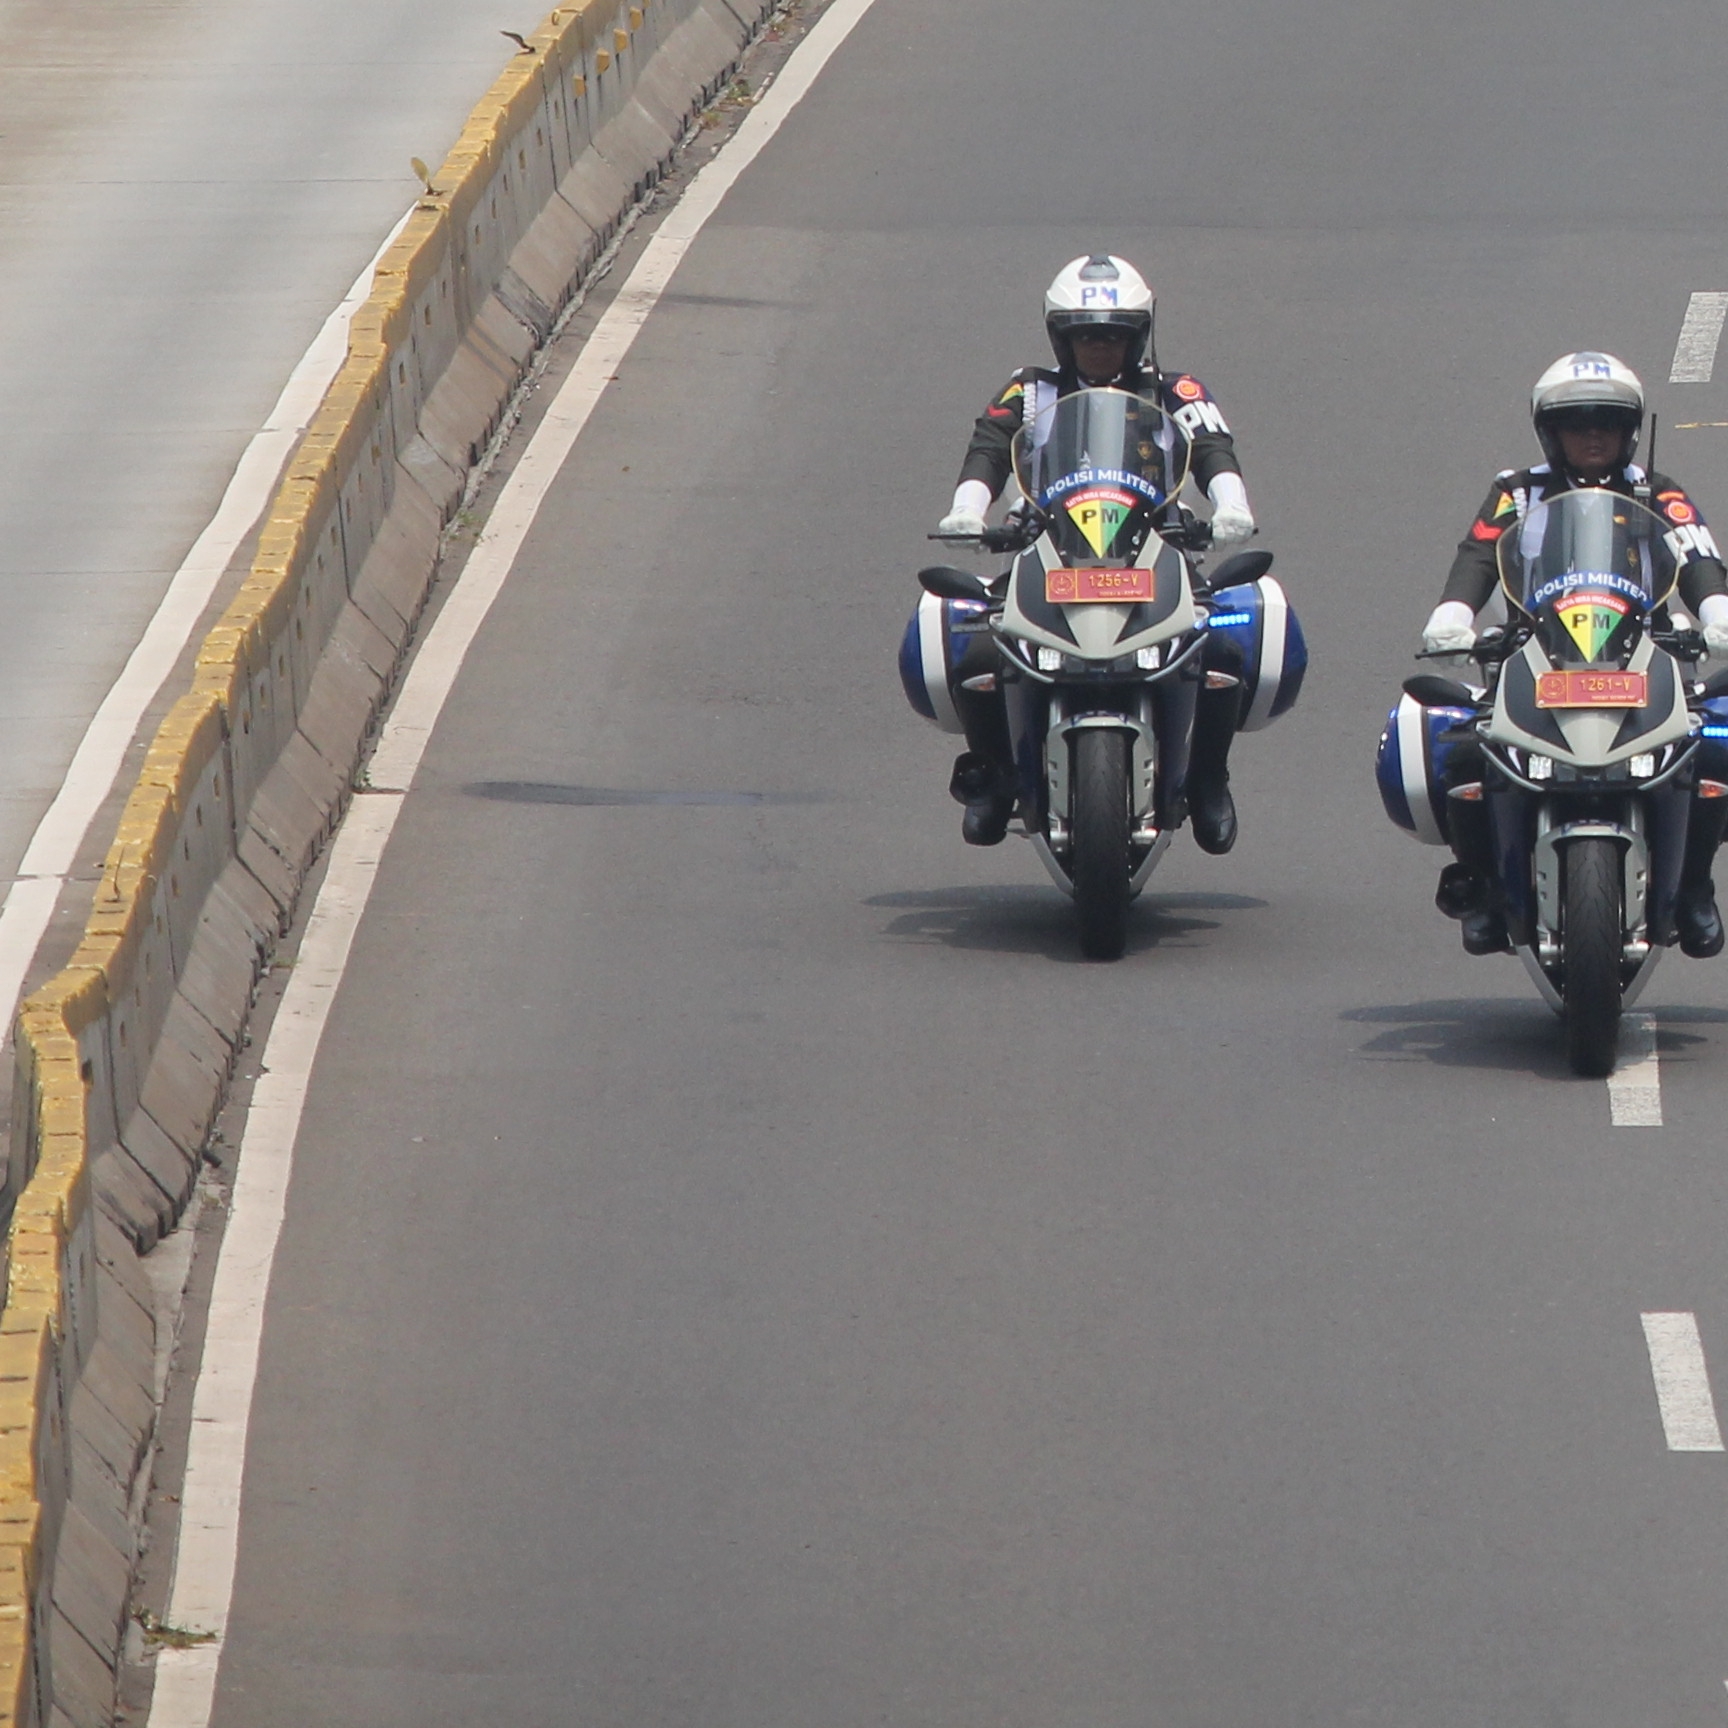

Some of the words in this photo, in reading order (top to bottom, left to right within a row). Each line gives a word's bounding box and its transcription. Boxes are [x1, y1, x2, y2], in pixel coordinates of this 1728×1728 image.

[1082, 287, 1117, 306] PM
[1572, 362, 1610, 378] PM
[1174, 400, 1230, 439] PM
[1046, 471, 1093, 499] POLISI
[1098, 469, 1157, 499] MILITER
[1081, 508, 1118, 524] PM
[1089, 573, 1138, 586] 1256-V
[1534, 574, 1583, 603] POLISI
[1572, 614, 1610, 629] PM
[1580, 678, 1631, 691] 1261-V
